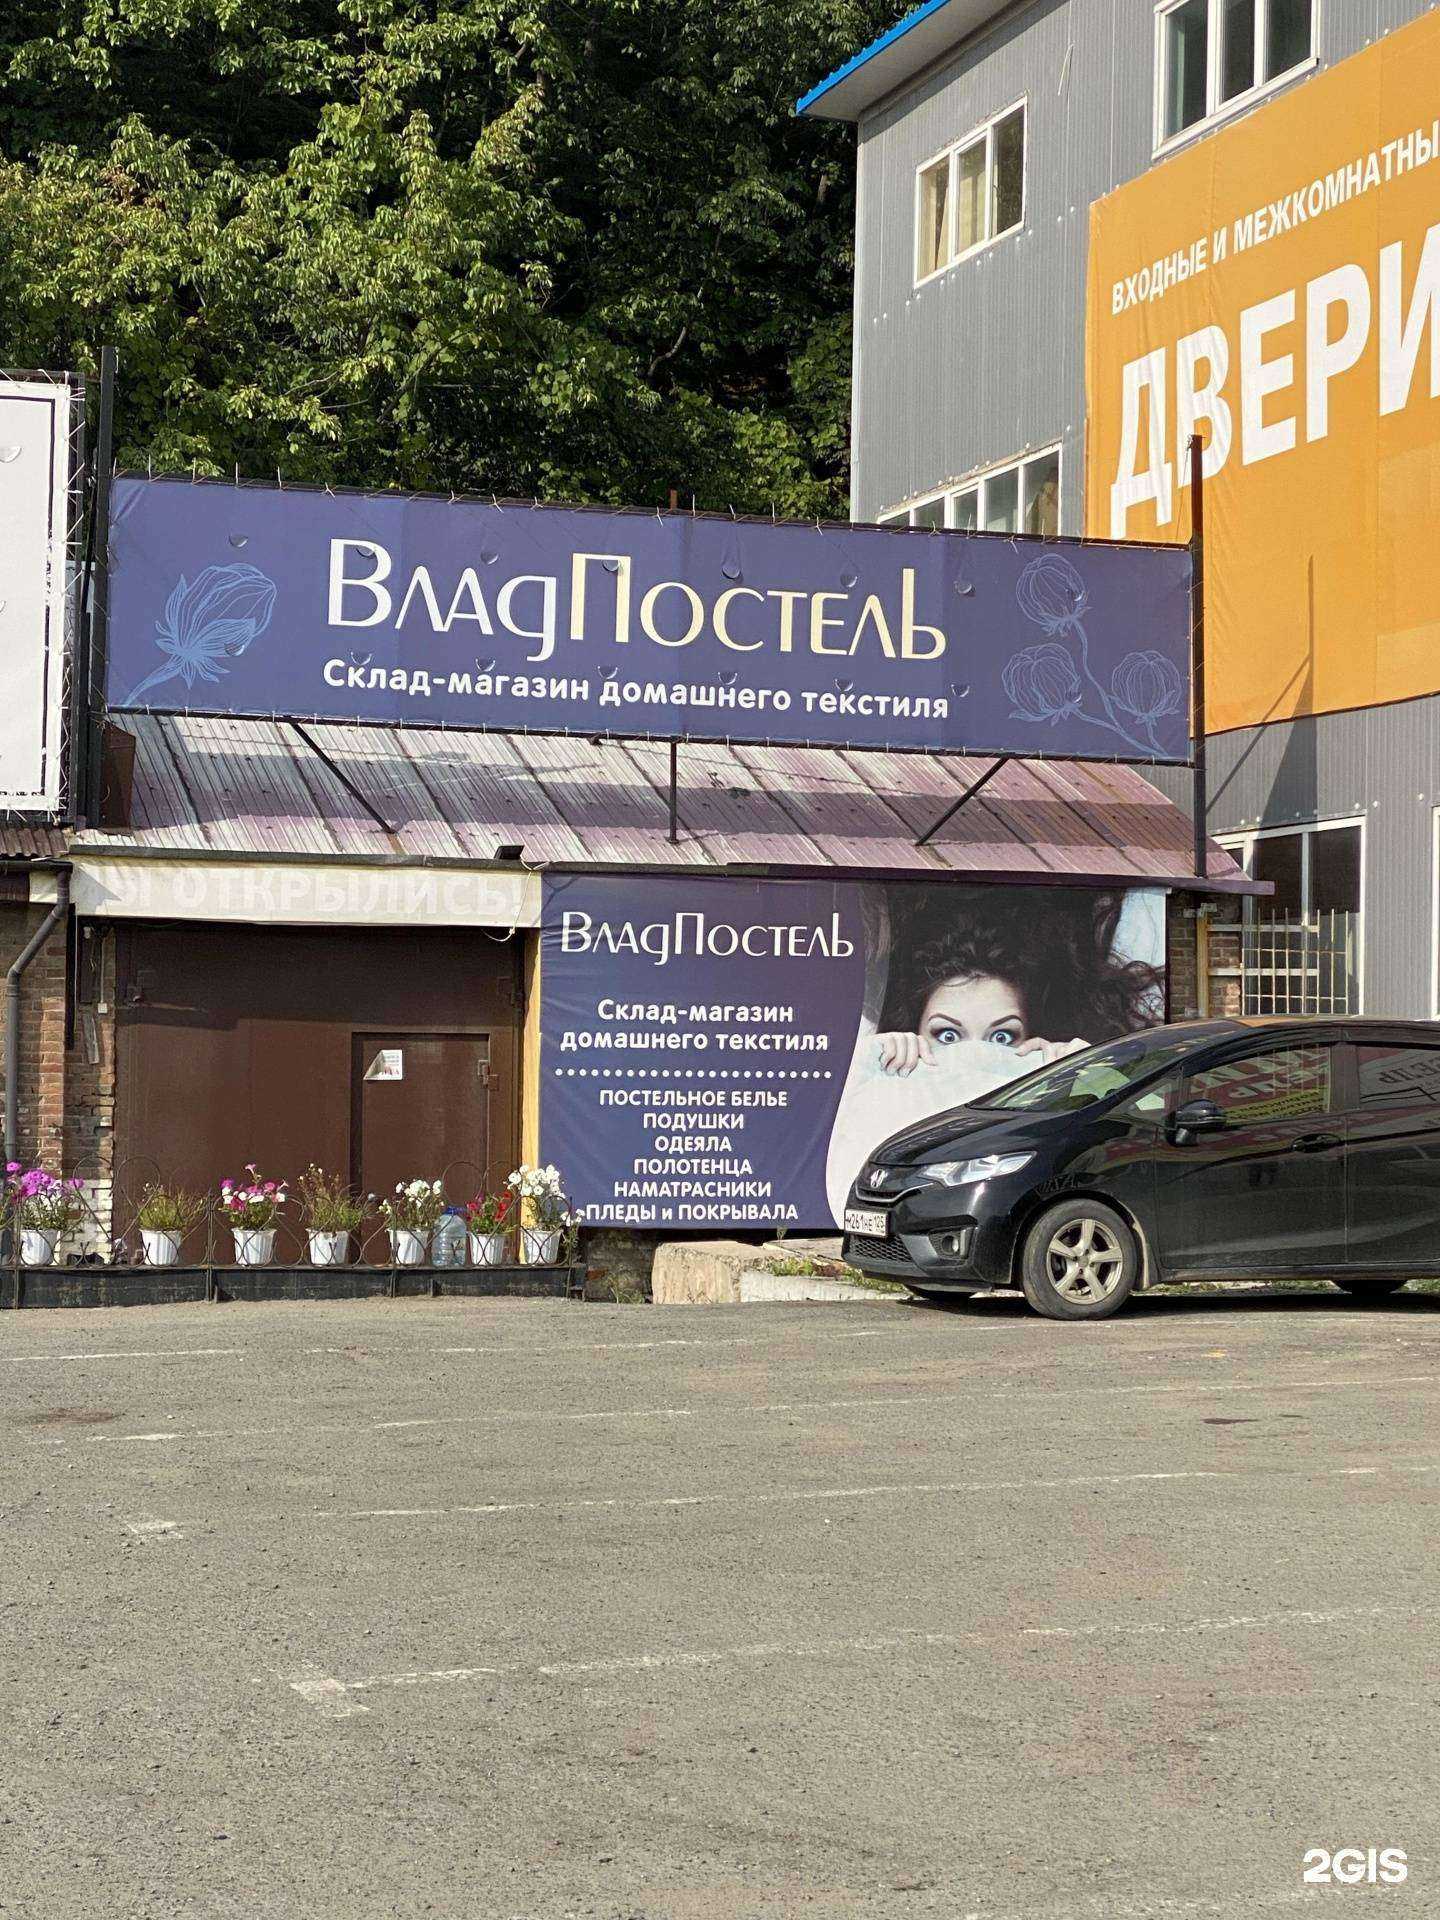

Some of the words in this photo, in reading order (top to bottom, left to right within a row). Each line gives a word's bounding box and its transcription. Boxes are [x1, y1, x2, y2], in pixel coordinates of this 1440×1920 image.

[1111, 237, 1208, 316] ВХОДНЫЕ
[1212, 226, 1227, 264] И
[1110, 222, 1440, 540] ДВЕРИ
[323, 658, 589, 701] Склад-магазин
[598, 678, 792, 710] домашнего
[801, 690, 949, 719] текстиля
[597, 999, 793, 1025] Склад-магазин
[560, 1030, 708, 1052] домашнего
[715, 1033, 829, 1051] текстиля
[600, 1089, 725, 1107] ПОСТЕЛЬНОЕ
[731, 1091, 788, 1107] БЕЛЬЕ
[643, 1112, 744, 1130] ПОДУШКИ
[654, 1135, 732, 1154] ОДЕЯЛА
[634, 1158, 753, 1177] ПОЛОТЕНЦА
[614, 1181, 772, 1198] НАМАТРАСНИКИ
[586, 1204, 656, 1223] ПЛЕДЫ
[661, 1208, 673, 1221] и
[678, 1204, 799, 1221] ПОКРЫВАЛА
